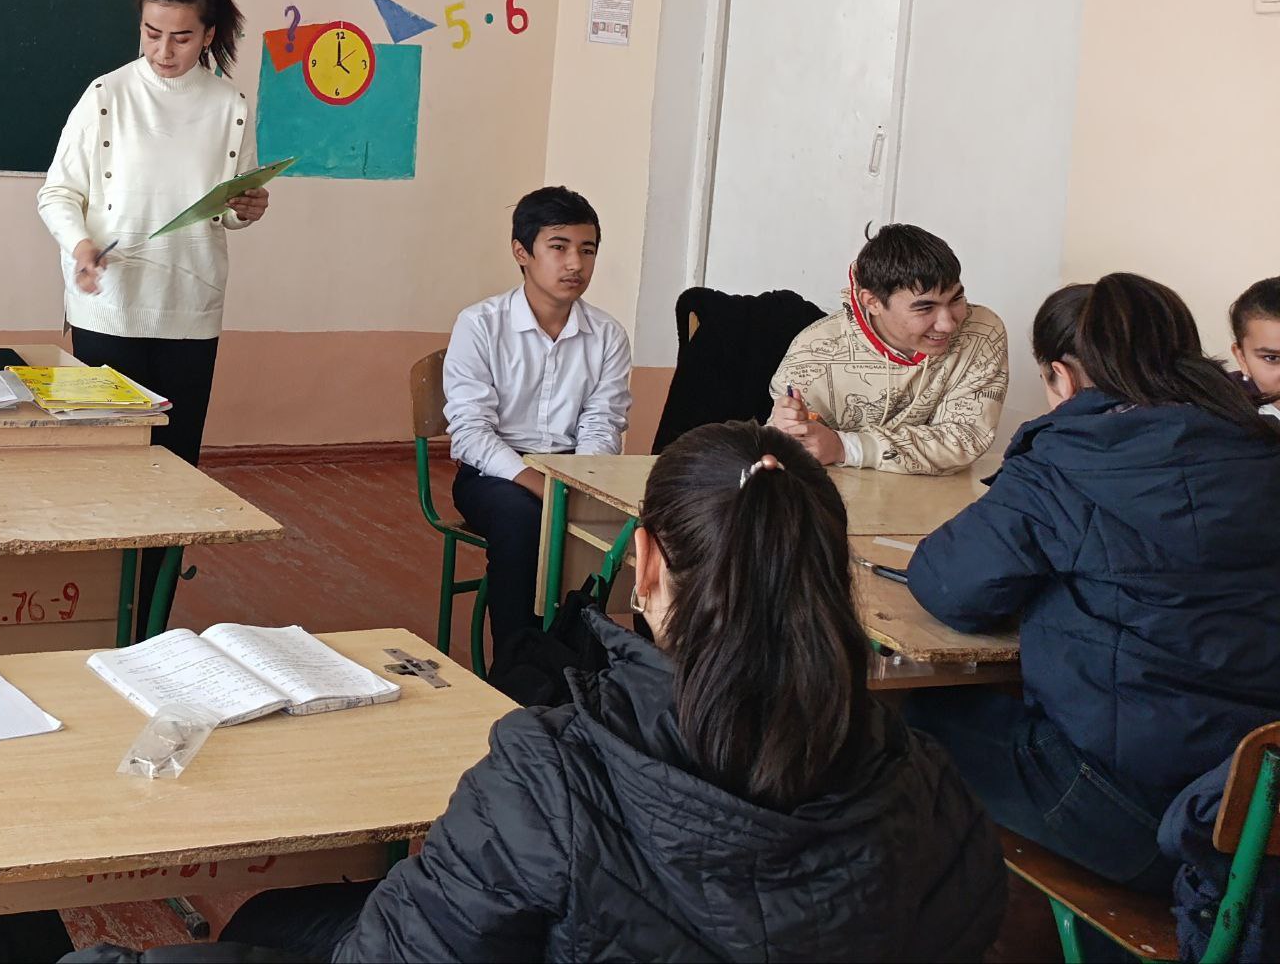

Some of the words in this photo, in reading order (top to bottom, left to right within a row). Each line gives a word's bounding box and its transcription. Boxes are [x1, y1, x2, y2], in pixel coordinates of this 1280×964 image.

[284, 5, 302, 54] ?
[444, 1, 472, 50] 5
[336, 32, 346, 40] 12
[311, 59, 317, 68] 9
[362, 60, 368, 70] 3
[335, 88, 340, 96] 6
